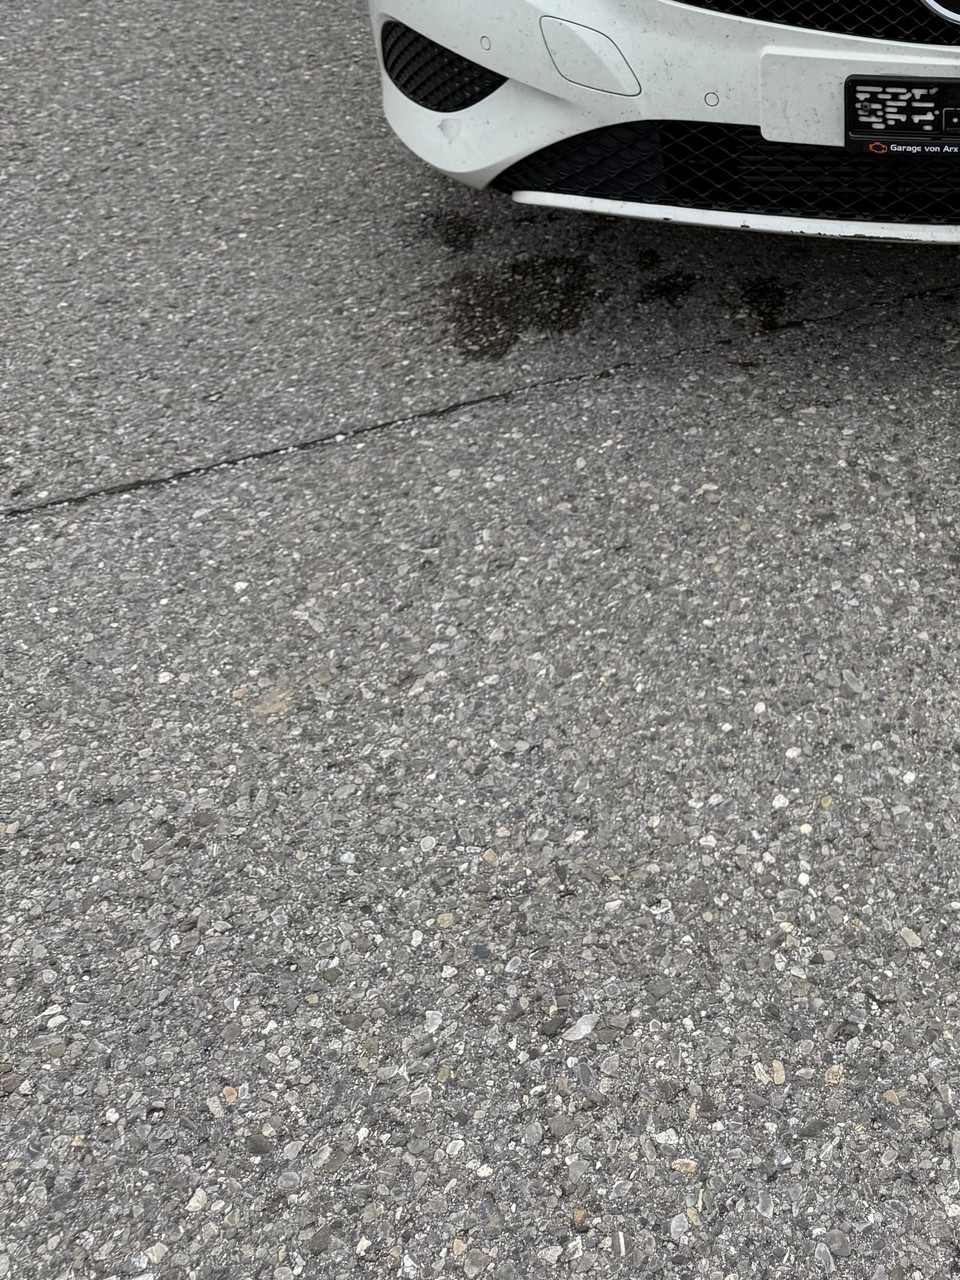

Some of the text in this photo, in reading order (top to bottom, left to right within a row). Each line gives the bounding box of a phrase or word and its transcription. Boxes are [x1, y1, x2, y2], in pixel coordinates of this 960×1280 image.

[890, 144, 922, 154] Garage
[924, 145, 940, 153] von
[942, 145, 959, 153] Arx
